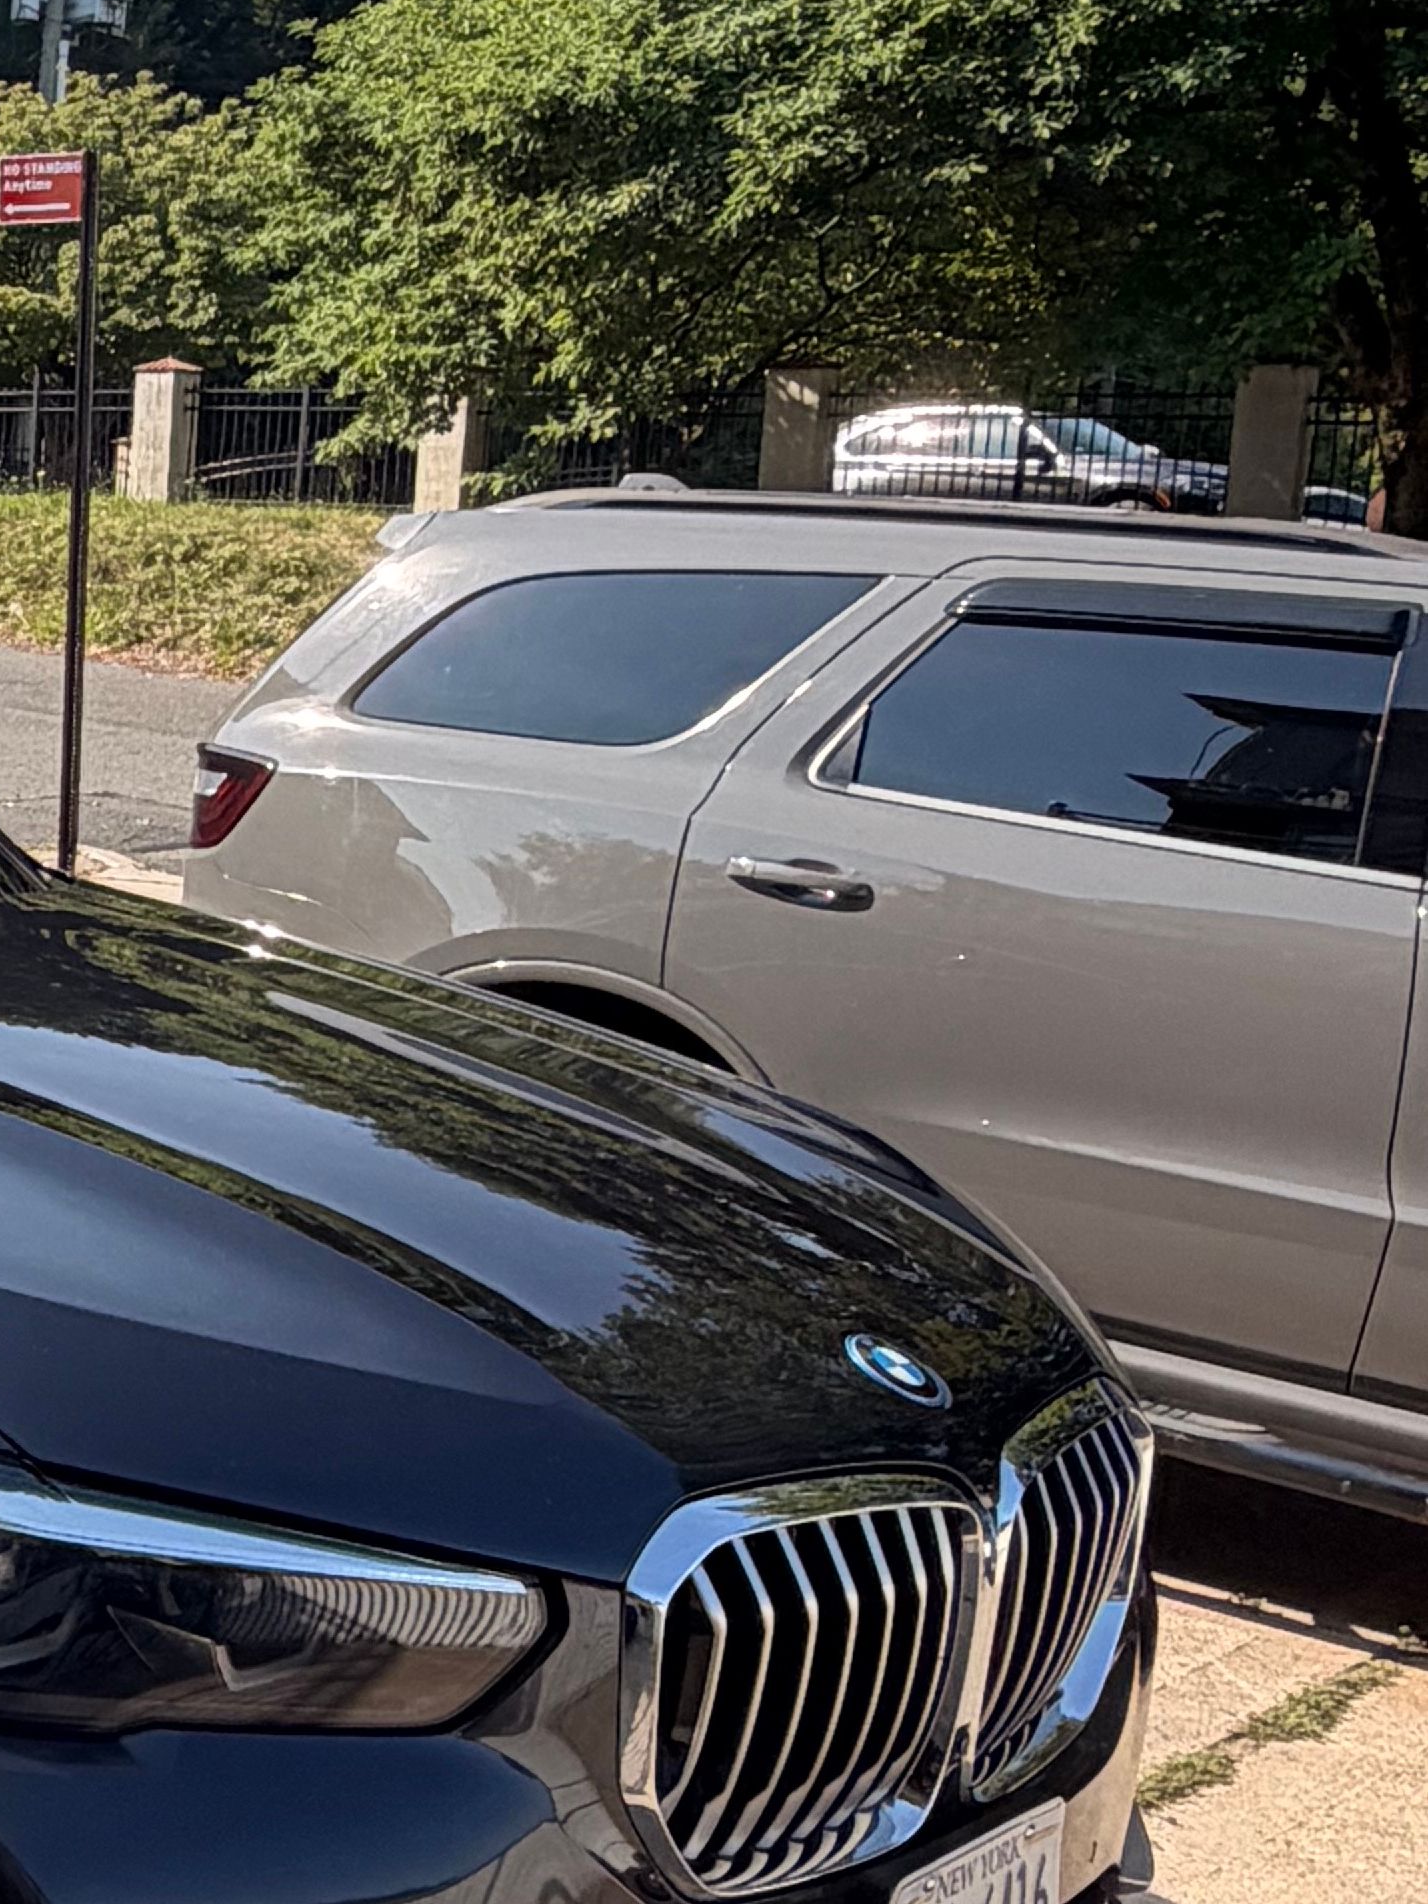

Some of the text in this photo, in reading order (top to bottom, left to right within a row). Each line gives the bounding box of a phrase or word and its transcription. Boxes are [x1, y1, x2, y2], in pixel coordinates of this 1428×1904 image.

[3, 160, 82, 176] NO STANDING
[3, 179, 53, 194] Anytime
[936, 1836, 1022, 1904] NEW YORK
